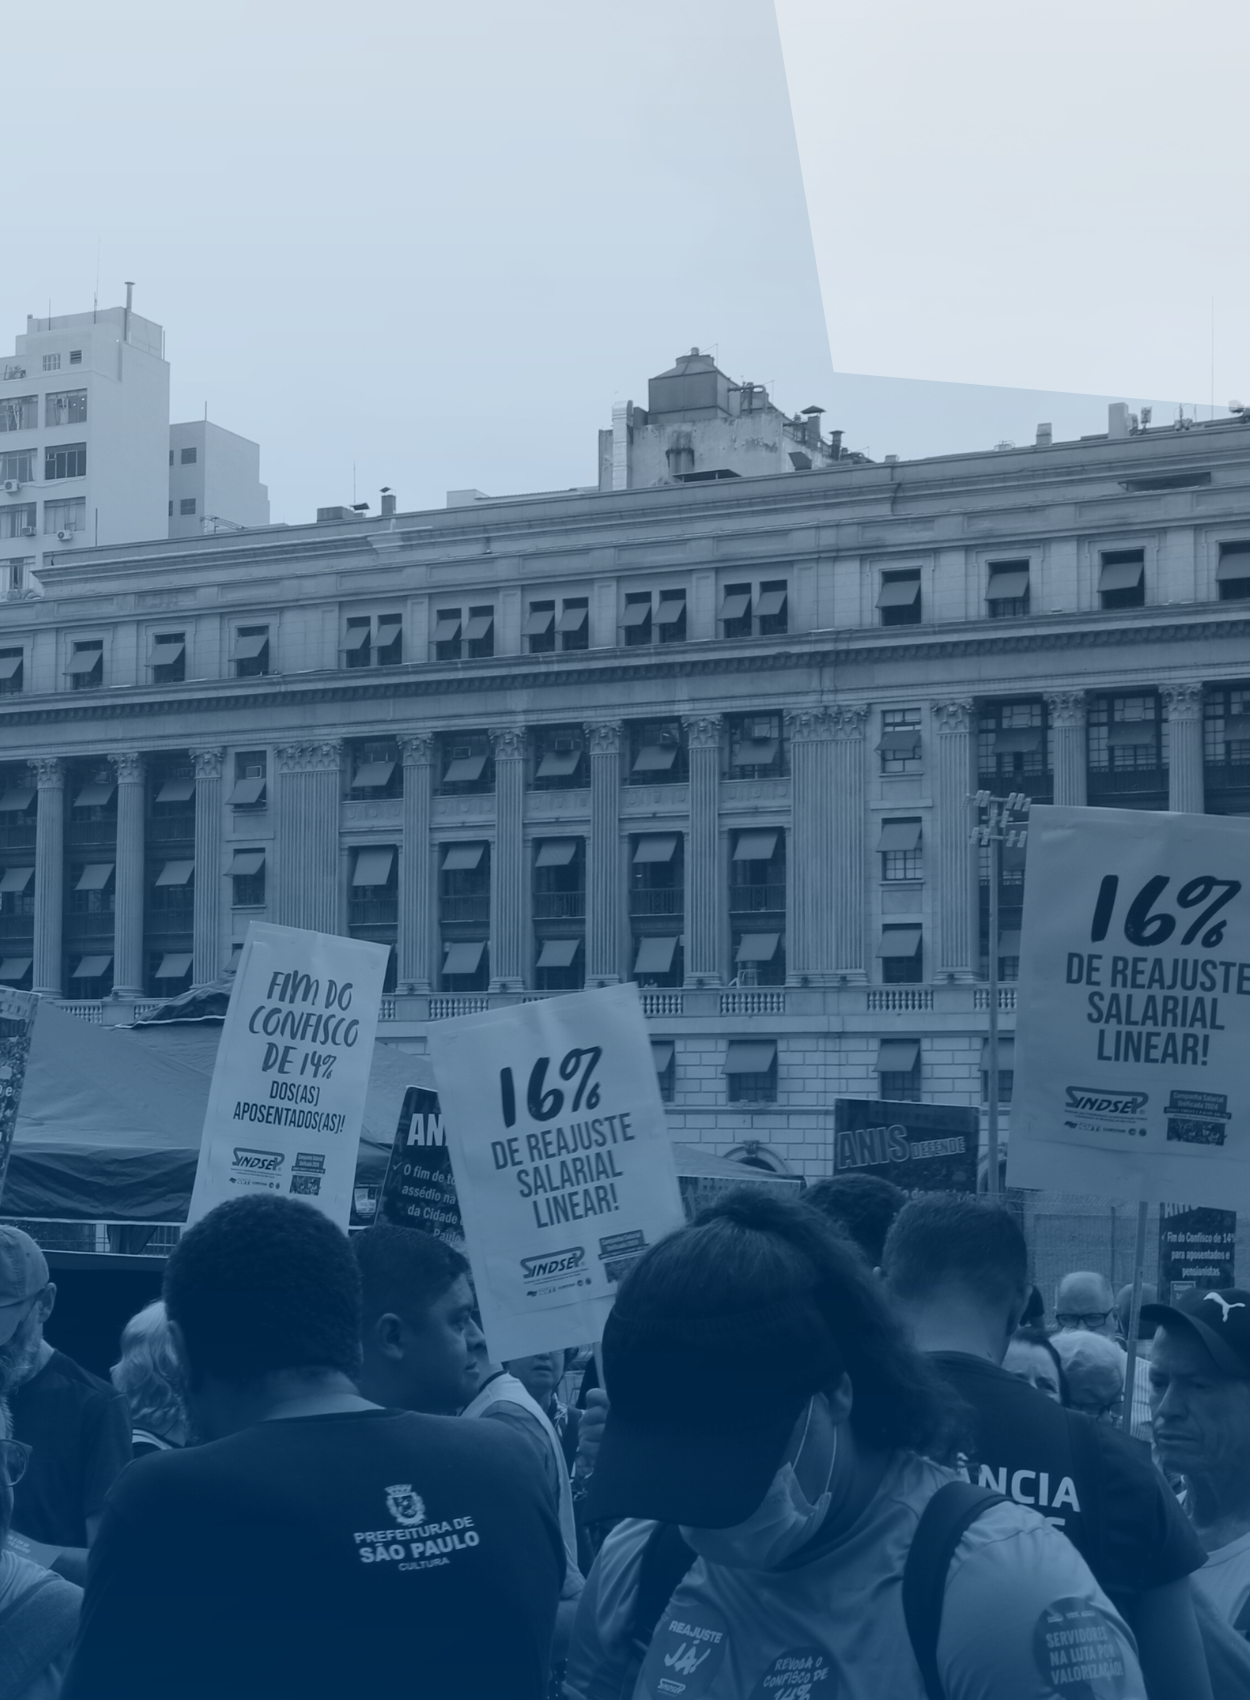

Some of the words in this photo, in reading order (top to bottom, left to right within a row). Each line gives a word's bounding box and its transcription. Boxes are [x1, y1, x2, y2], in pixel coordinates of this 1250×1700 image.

[1090, 874, 1242, 949] 16%
[266, 969, 320, 1006] FIM
[324, 979, 353, 1011] DO
[1065, 952, 1103, 987] DE
[1110, 955, 1250, 996] REAJUSTE
[248, 1005, 360, 1048] CONFISCO
[1086, 991, 1226, 1031] SALARIAL
[261, 1041, 298, 1075] DE
[299, 1050, 338, 1079] 14%
[1097, 1029, 1210, 1067] LINEAR!
[5, 1086, 13, 1097] e
[269, 1080, 321, 1107] DOS(AS)
[499, 1046, 602, 1129] 16%
[232, 1101, 346, 1135] APOSENTADOS(AS)!
[406, 1113, 449, 1146] AN
[490, 1138, 523, 1171] DE
[526, 1112, 637, 1164] REAJUSTE
[837, 1124, 910, 1170] ANIS
[910, 1136, 966, 1160] DEFENDE
[403, 1163, 412, 1176] O
[413, 1165, 430, 1180] fim
[431, 1170, 445, 1183] de
[516, 1149, 624, 1198] SALARIAL
[401, 1185, 441, 1202] assédio
[532, 1182, 621, 1229] LINEAR!
[407, 1203, 421, 1217] da
[422, 1206, 458, 1225] Cidade
[1167, 1231, 1178, 1243] Fim
[1178, 1232, 1185, 1243] do
[1186, 1232, 1212, 1243] Confisco
[1213, 1232, 1221, 1243] de
[1171, 1250, 1185, 1261] para
[1186, 1249, 1225, 1261] aposentados
[1225, 1252, 1230, 1260] e
[1182, 1265, 1221, 1278] pensionistas
[353, 1521, 453, 1544] PREFEITURA
[453, 1515, 475, 1531] DE
[358, 1542, 406, 1564] SÃO
[409, 1530, 481, 1559] PAULO
[397, 1556, 451, 1571] CULTURA
[667, 1619, 724, 1645] REAJUSTE
[663, 1639, 712, 1676] JÁ!
[774, 1655, 813, 1672] REVOGA
[815, 1656, 823, 1668] O
[1049, 1649, 1068, 1667] NA
[1070, 1645, 1097, 1663] LUTA
[1097, 1643, 1116, 1659] POR
[762, 1669, 810, 1689] CONFISCO
[813, 1666, 830, 1682] DE
[1050, 1658, 1124, 1686] VALORIZAÇÃO!
